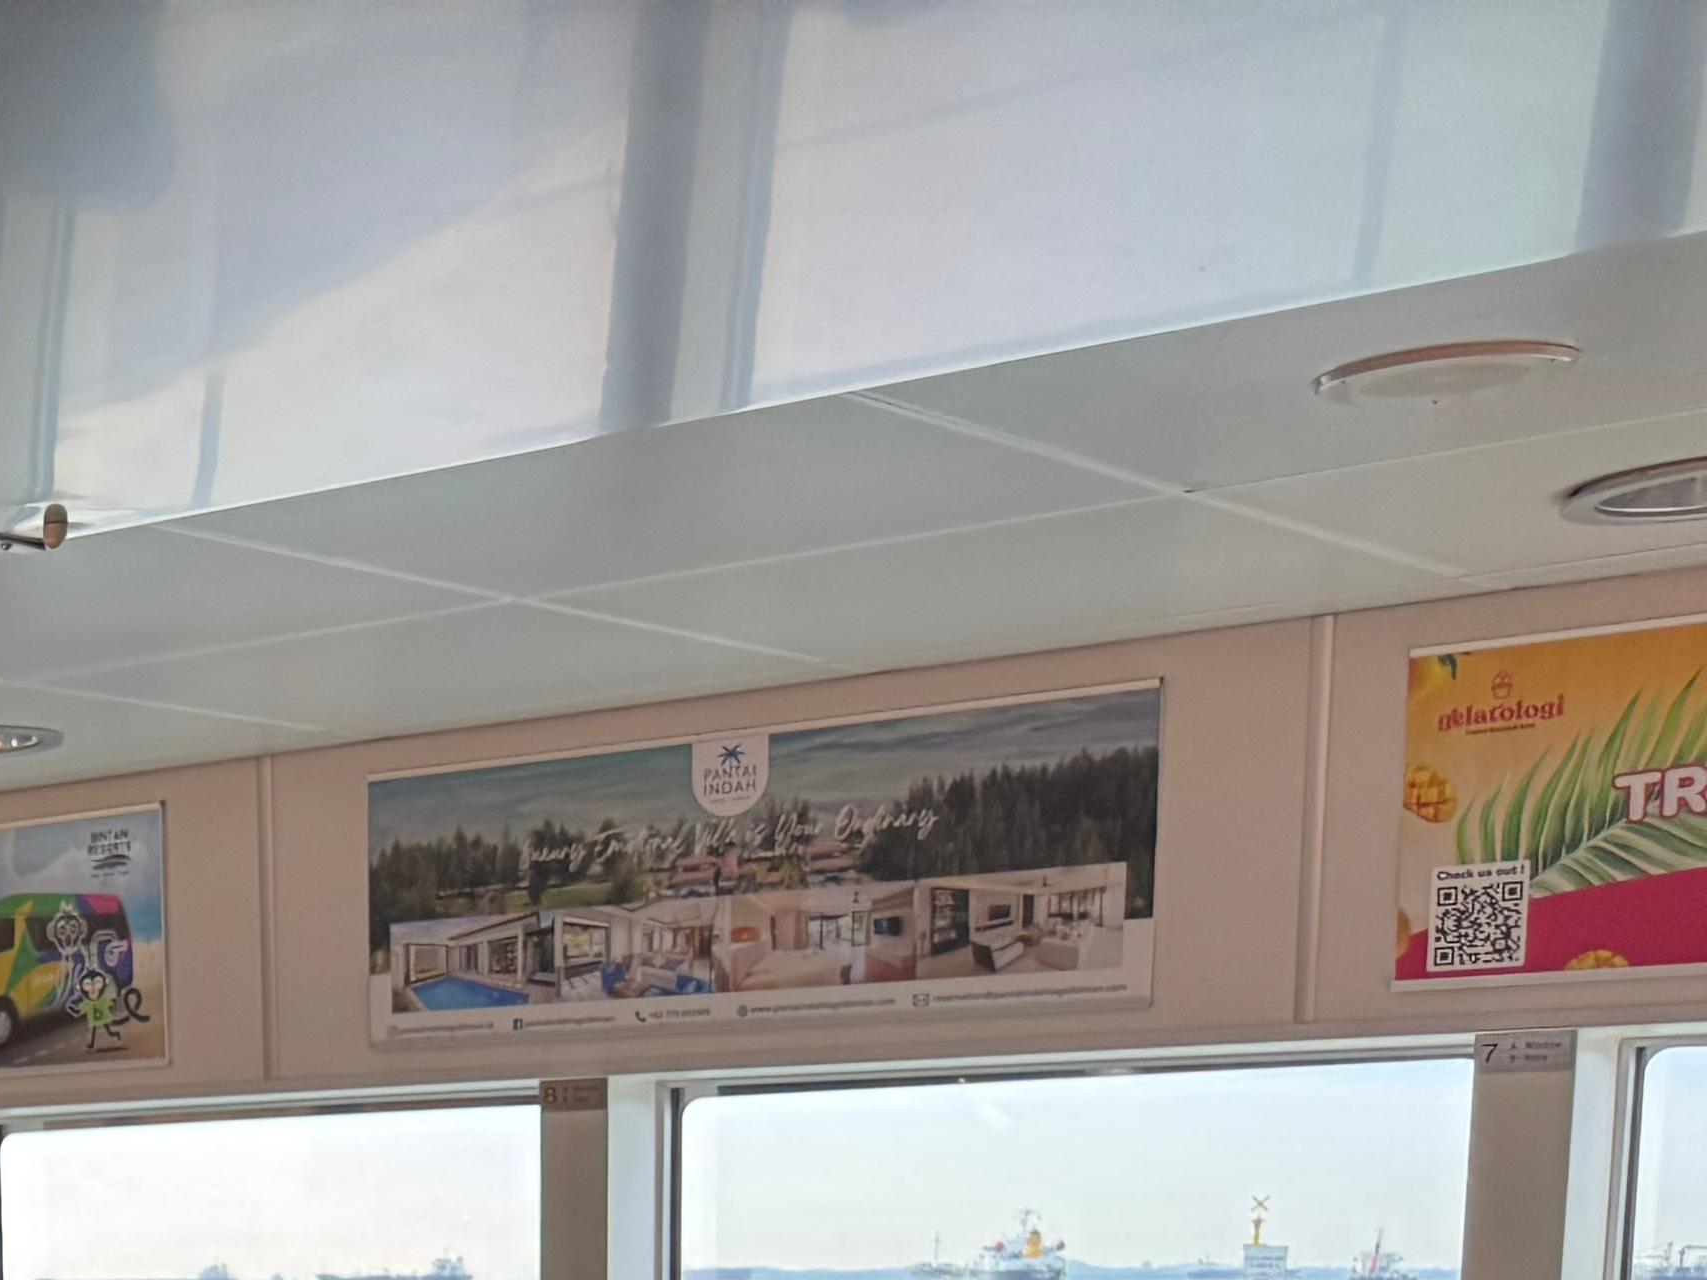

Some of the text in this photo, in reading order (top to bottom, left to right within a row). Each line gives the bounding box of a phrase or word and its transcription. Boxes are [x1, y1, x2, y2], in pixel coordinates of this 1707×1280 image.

[704, 765, 756, 782] PANTAI
[704, 779, 756, 796] INDAH
[1436, 868, 1474, 881] Check
[1477, 869, 1493, 878] us
[1480, 1043, 1498, 1064] 7
